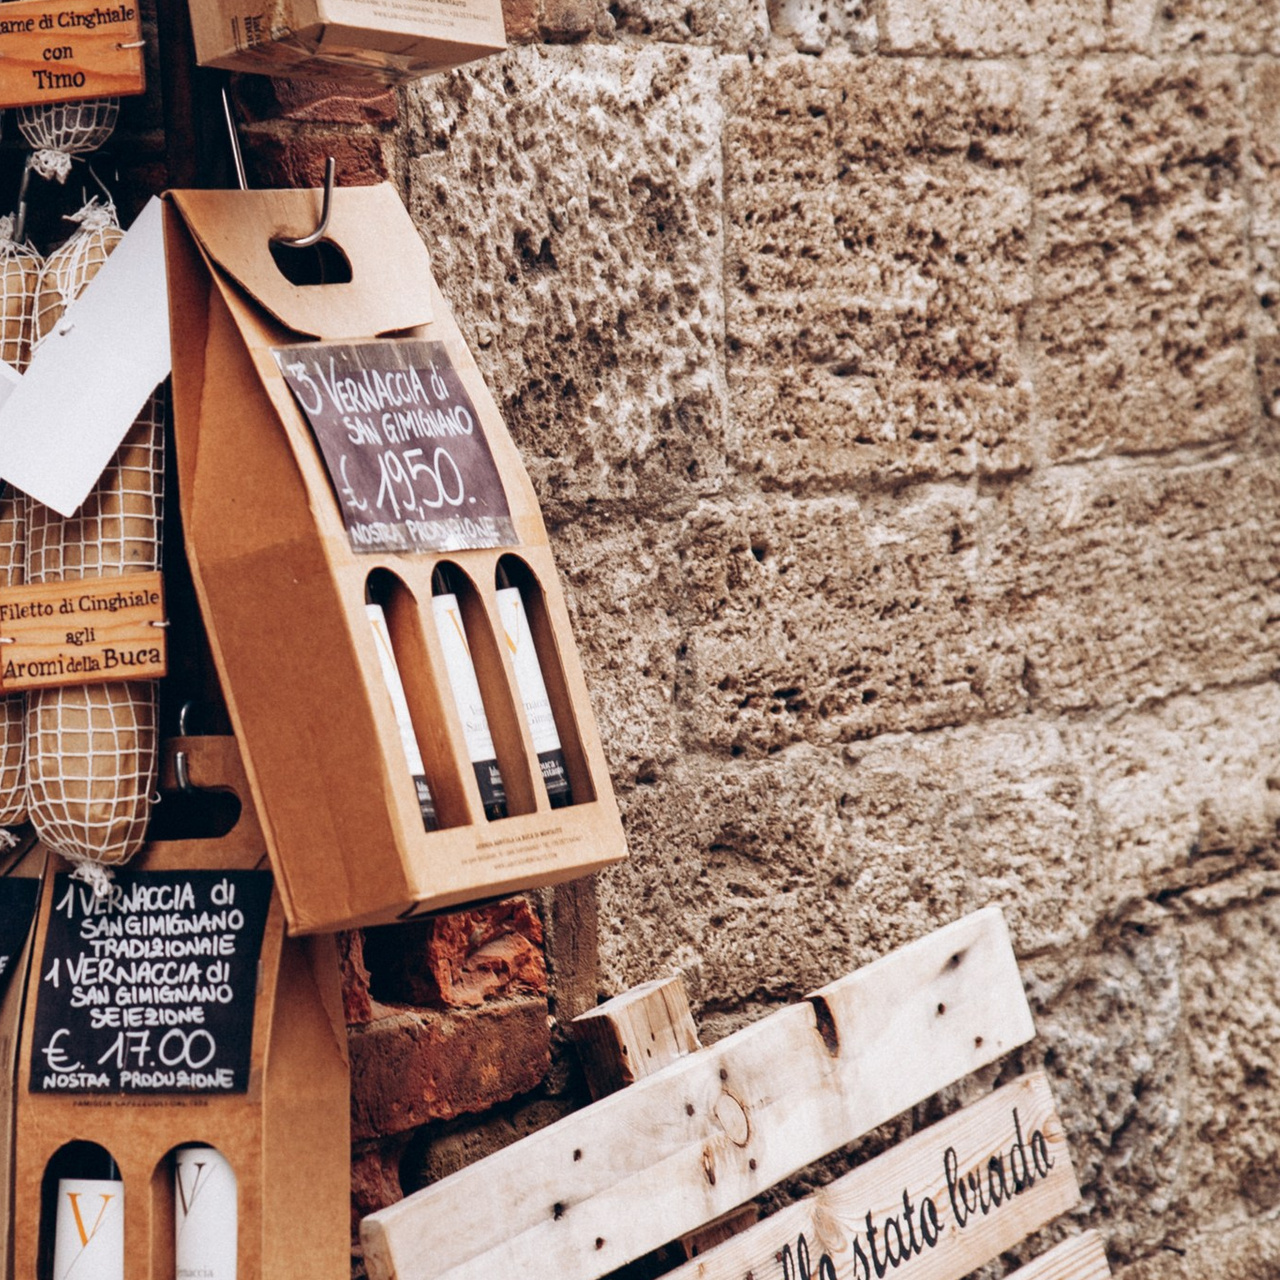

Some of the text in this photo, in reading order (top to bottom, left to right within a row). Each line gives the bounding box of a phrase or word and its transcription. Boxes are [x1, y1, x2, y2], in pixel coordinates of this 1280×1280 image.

[38, 11, 54, 30] di
[57, 5, 136, 30] Cinghiale
[43, 45, 74, 61] con
[33, 69, 87, 91] Timo
[319, 356, 425, 416] VERNACCIA
[343, 405, 474, 446] SAN GIMIGNANO
[350, 521, 403, 546] NOSTRA
[0, 589, 160, 621] Filetto di Cinghiale
[66, 626, 96, 647] agli
[2, 645, 162, 680] Aromi della Buca
[79, 882, 196, 916] VERNACCIA
[80, 909, 244, 940] SAN GIMIGNANO
[67, 952, 203, 986] VERNACCIA
[71, 984, 234, 1008] SAN GIMIGNANO
[97, 1028, 217, 1070] 17.00
[43, 1067, 235, 1090] NOSTRA PRODUZIONE
[941, 1106, 1057, 1232] brado
